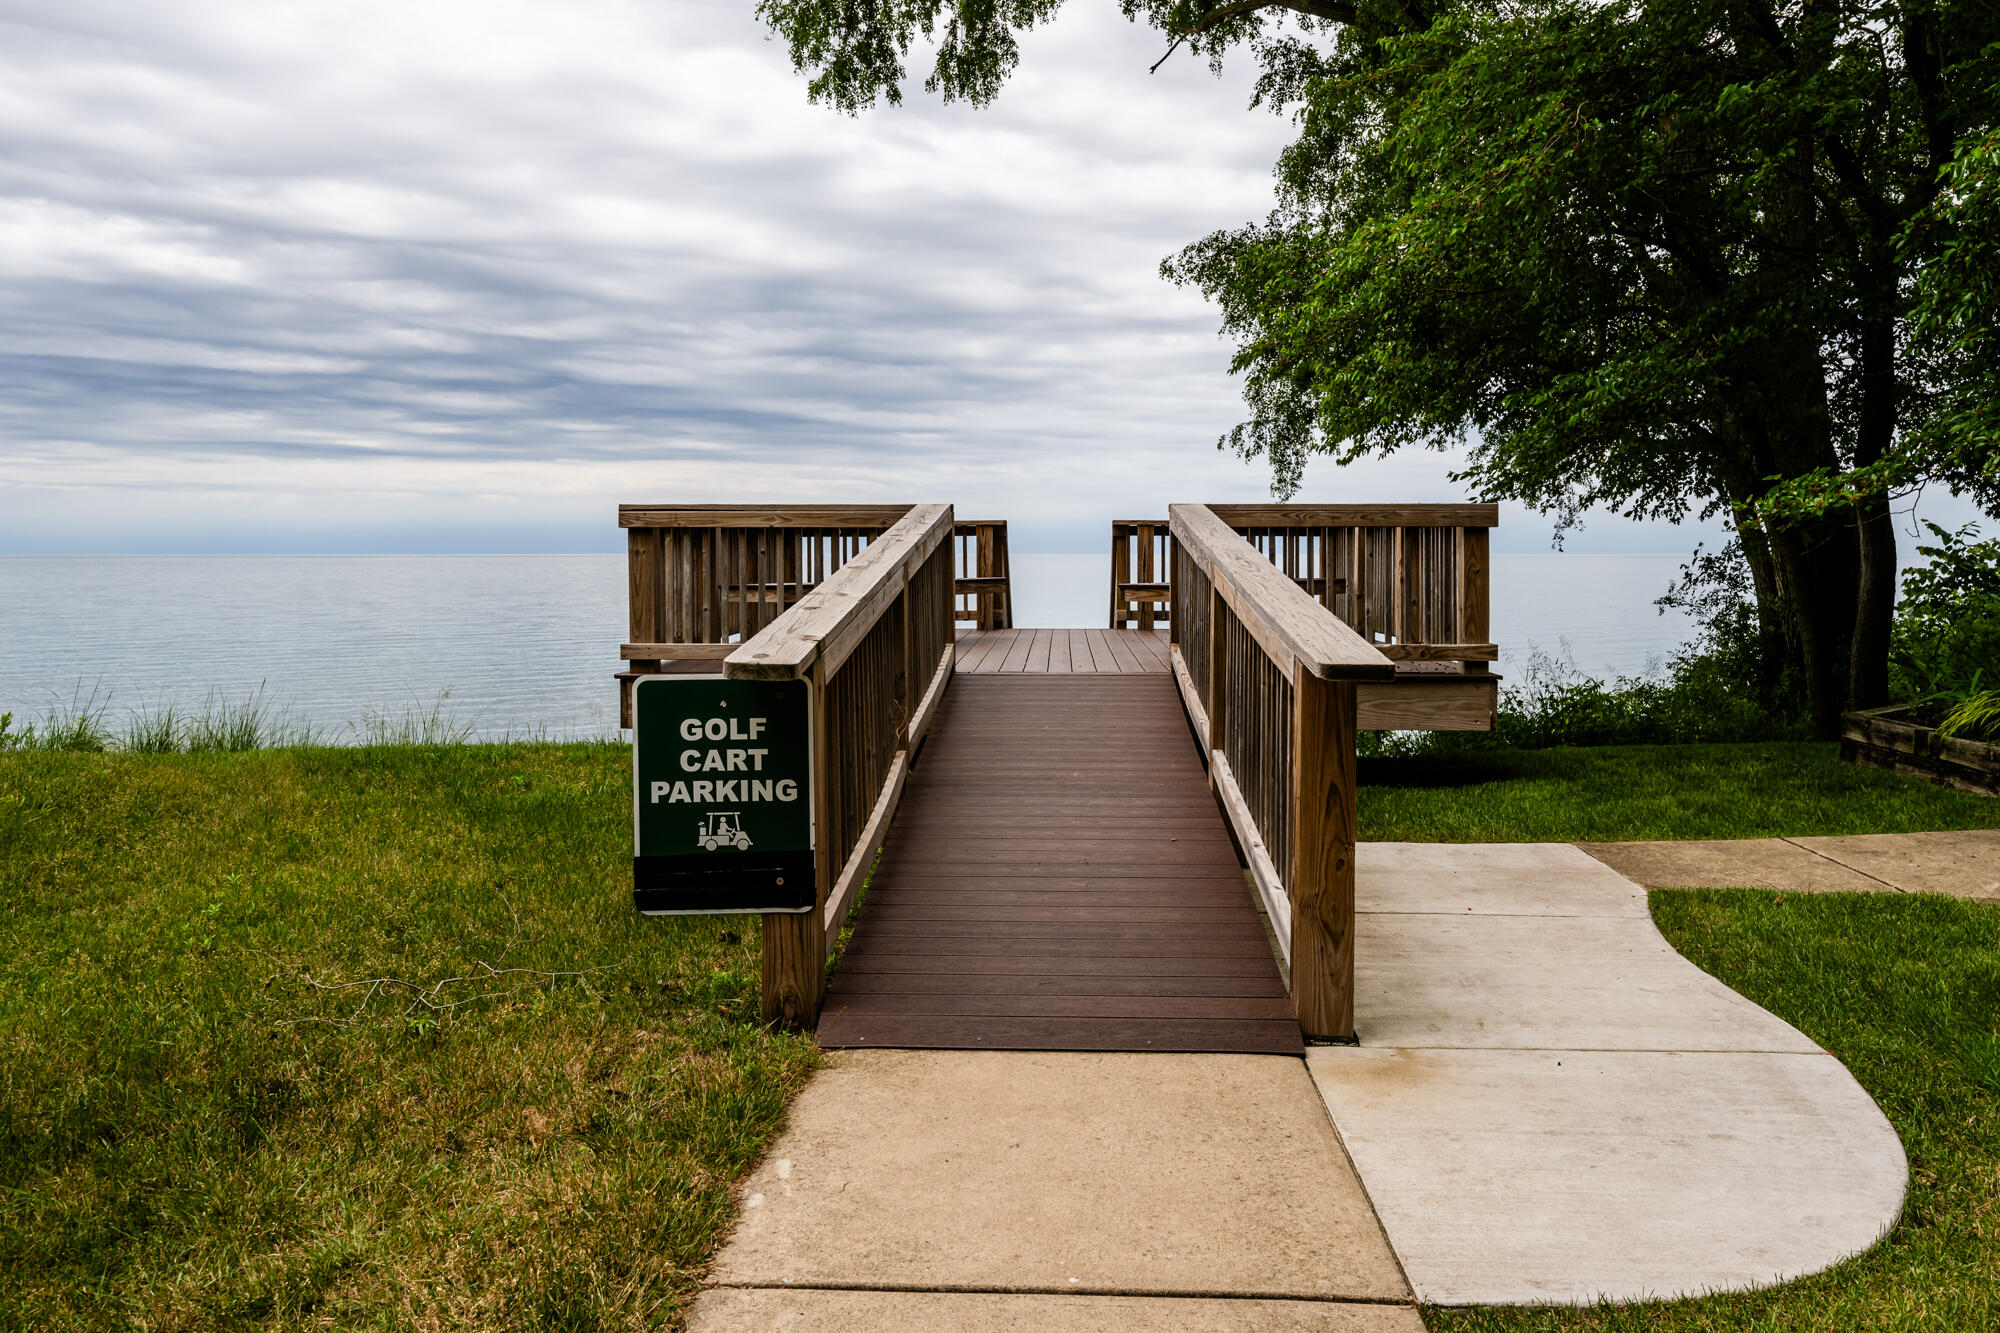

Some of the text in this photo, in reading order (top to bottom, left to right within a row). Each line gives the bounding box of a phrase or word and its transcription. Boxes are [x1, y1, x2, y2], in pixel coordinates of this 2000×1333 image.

[680, 718, 767, 741] GOLF
[680, 749, 768, 772] CART
[651, 779, 798, 804] PARKING
